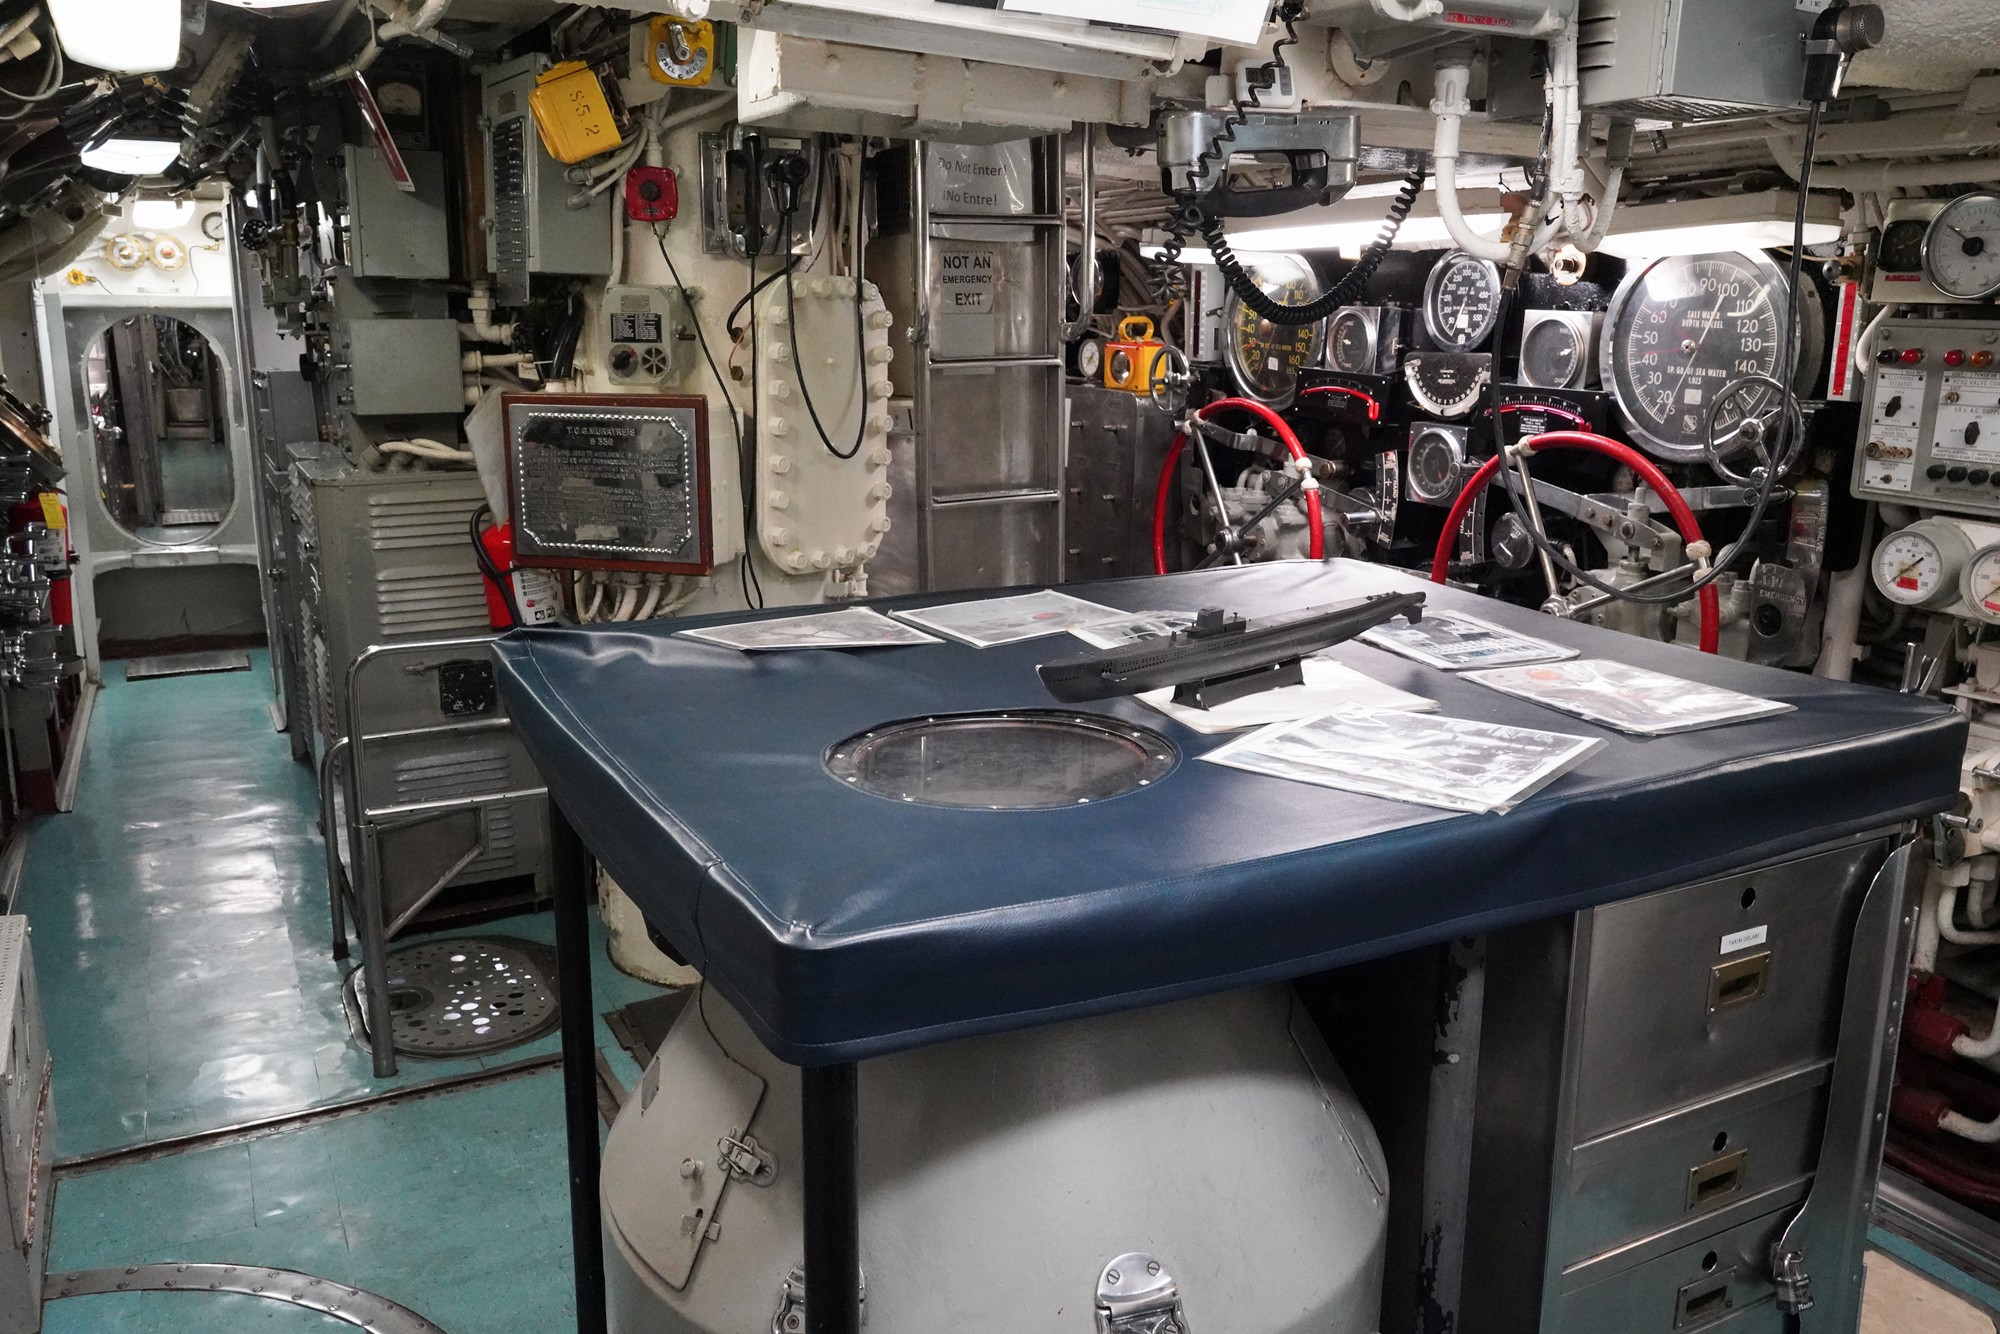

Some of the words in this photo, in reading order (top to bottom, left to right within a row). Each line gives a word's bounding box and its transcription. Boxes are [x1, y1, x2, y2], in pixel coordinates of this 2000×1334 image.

[938, 157, 951, 170] Do
[955, 160, 972, 174] Not
[964, 194, 997, 206] Entre!
[944, 256, 969, 269] NOT
[974, 257, 991, 269] AN
[943, 275, 992, 284] EMERGENCY
[1700, 278, 1717, 292] 90
[1681, 283, 1696, 296] 80
[1718, 283, 1740, 297] 100
[955, 293, 983, 306] EXIT
[1736, 300, 1755, 313] 110
[1473, 314, 1483, 322] 550
[1651, 311, 1667, 324] 60
[1687, 311, 1701, 319] SALT
[1682, 319, 1700, 328] DEPTH
[1737, 320, 1759, 334] 120
[1298, 330, 1309, 339] 140
[1643, 331, 1658, 345] 50
[1295, 342, 1306, 353] 150
[1741, 338, 1761, 352] 130
[1252, 351, 1261, 360] 20
[1289, 355, 1300, 366] 160
[1641, 354, 1658, 366] 40
[1696, 368, 1706, 376] SEA
[1708, 369, 1727, 378] WATER
[1735, 360, 1757, 374] 140
[1648, 372, 1662, 385] 30
[1657, 391, 1672, 404] 20
[597, 438, 614, 447] 336
[1815, 526, 1826, 552] VALVE
[1759, 589, 1807, 605] EMERGENCY
